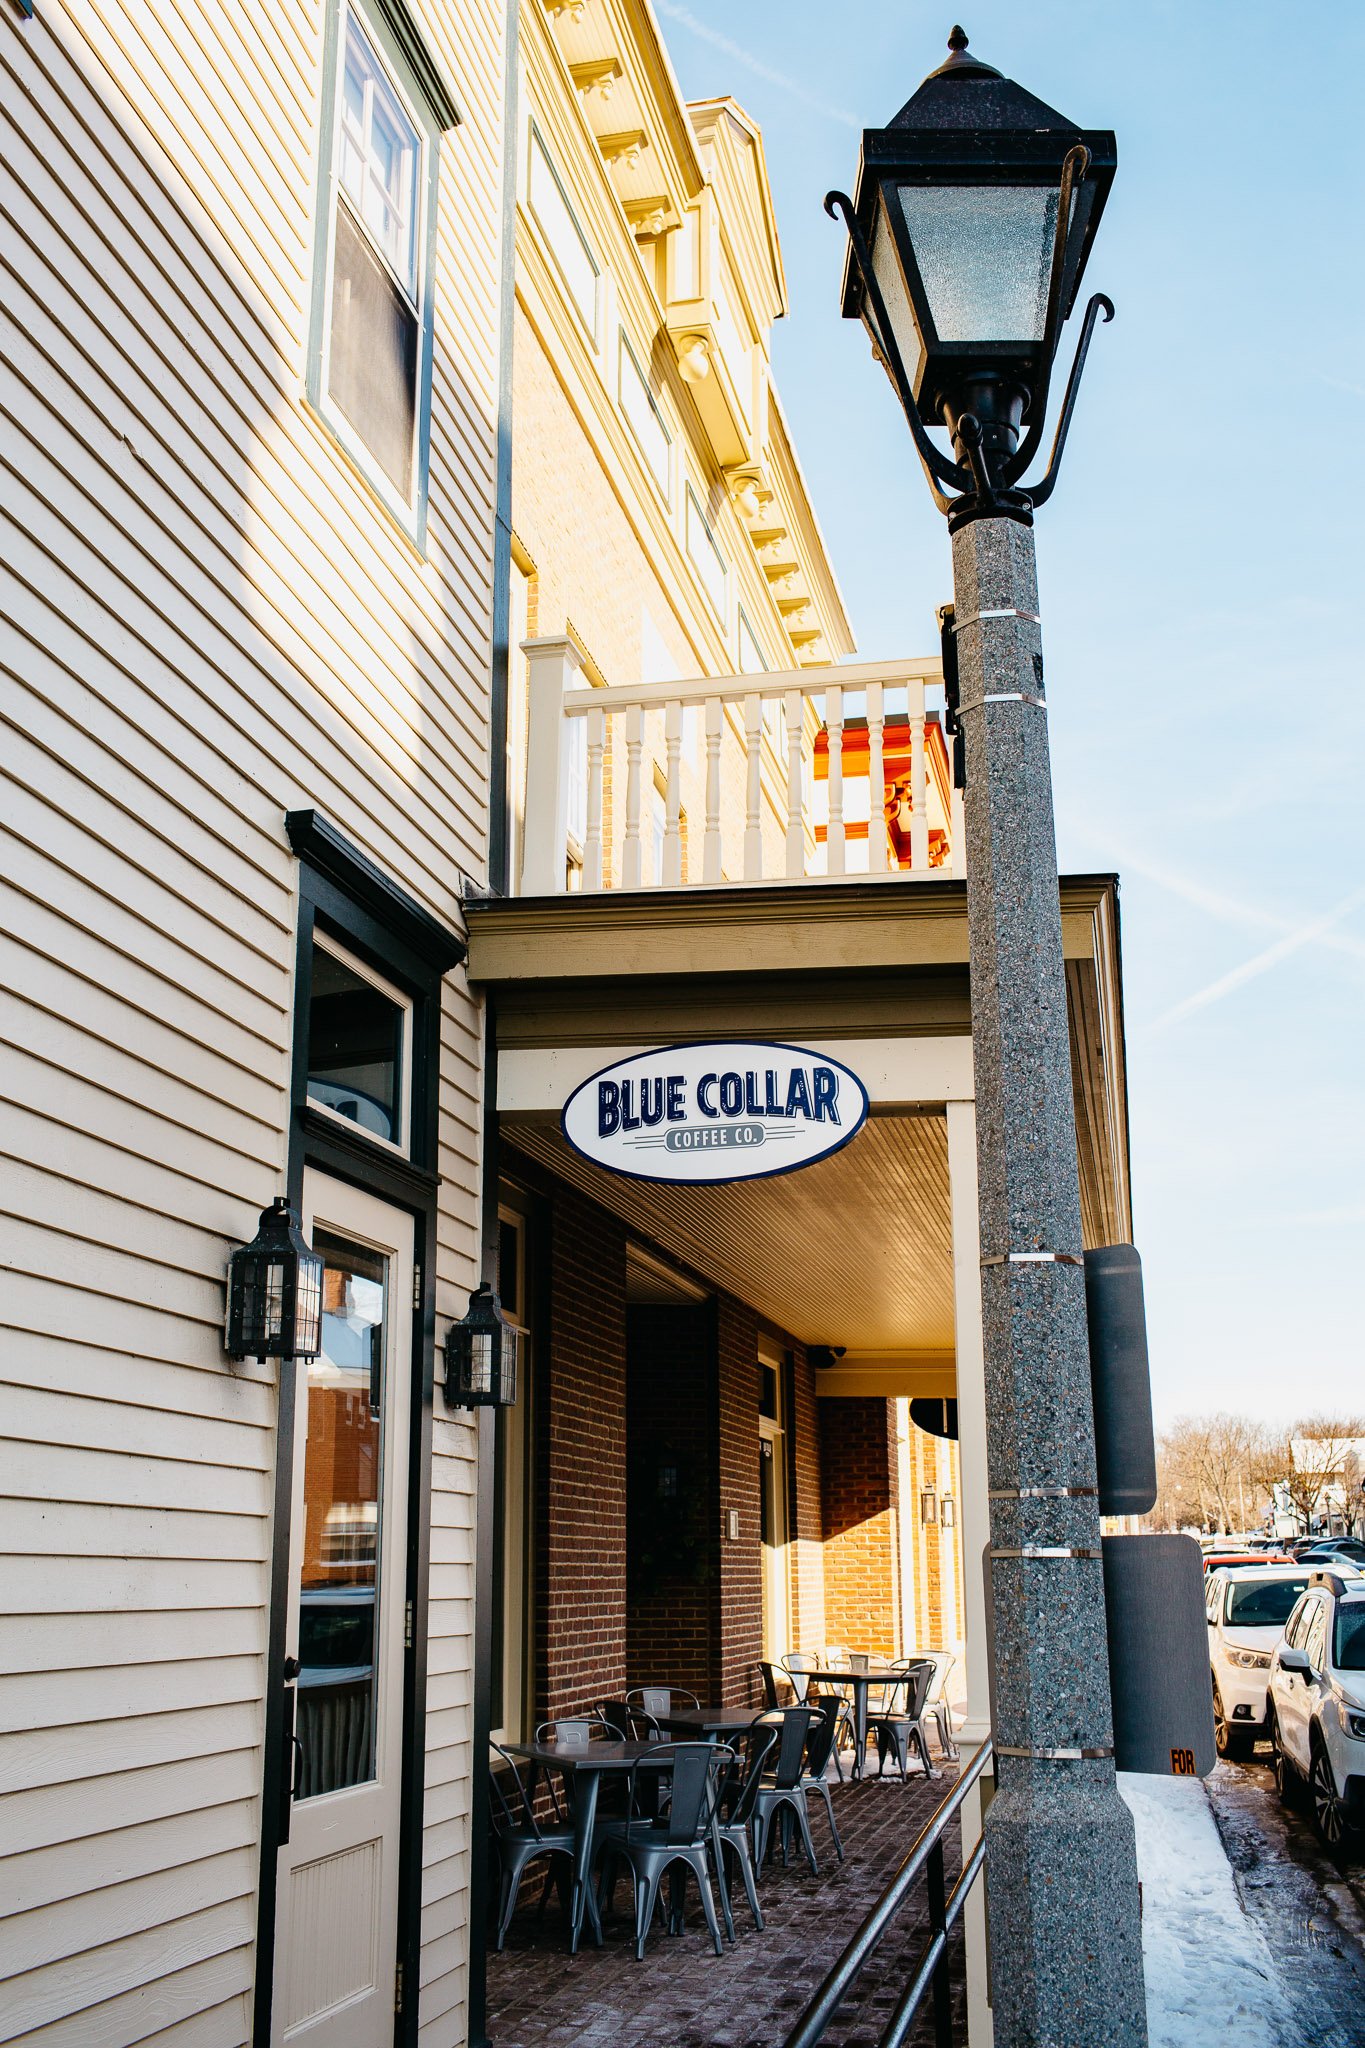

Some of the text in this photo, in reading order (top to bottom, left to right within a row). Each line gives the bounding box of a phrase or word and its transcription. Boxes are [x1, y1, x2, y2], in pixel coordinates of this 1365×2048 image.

[598, 1067, 842, 1139] BLUE COLLAR
[674, 1127, 758, 1148] COFFEE CO.
[1171, 1749, 1195, 1774] FOR
